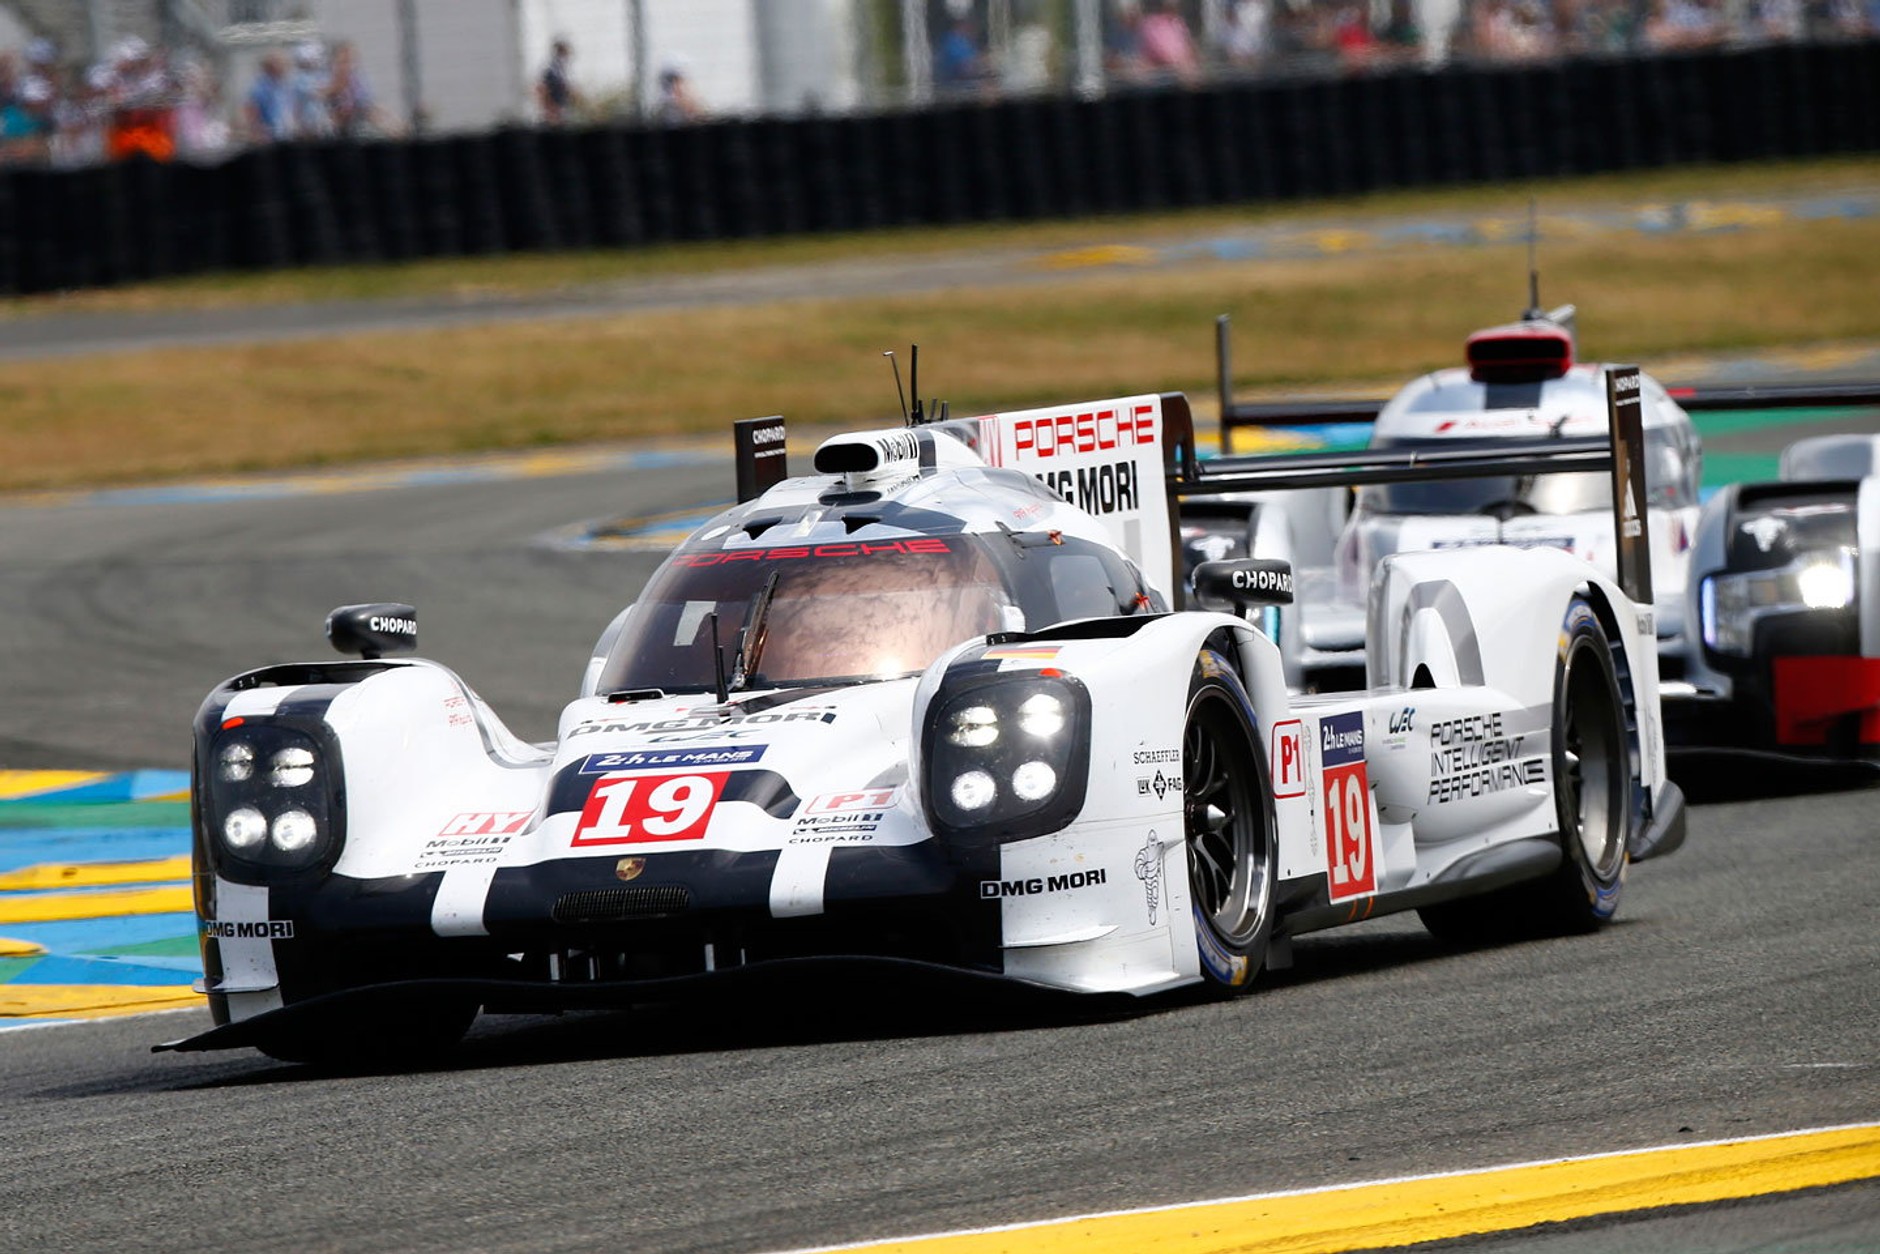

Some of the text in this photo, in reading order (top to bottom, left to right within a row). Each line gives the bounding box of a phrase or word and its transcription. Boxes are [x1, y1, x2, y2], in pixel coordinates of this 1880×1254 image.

[753, 425, 785, 444] CHOPARD
[1015, 405, 1154, 461] PORSCHE
[1078, 460, 1139, 516] MORI
[672, 538, 950, 567] PORSCHE
[370, 616, 417, 635] CHOPARD
[567, 715, 693, 740] DMG
[1389, 707, 1415, 734] WEC
[1431, 712, 1503, 748] PORSCHE
[1336, 733, 1345, 748] LE
[648, 754, 681, 764] LE
[681, 750, 753, 763] MANS
[1133, 749, 1180, 764] SCHAEFFLER
[1281, 734, 1302, 784] P1
[1431, 736, 1525, 776] INTELLIGENT
[1167, 777, 1183, 791] FAG
[1428, 758, 1546, 805] PERFORMANCE
[578, 775, 714, 840] 19
[825, 790, 894, 809] P1
[439, 812, 531, 836] HY
[797, 813, 859, 826] Mobil
[1329, 774, 1366, 884] 19
[425, 837, 488, 848] Mobil
[789, 835, 873, 844] CHOPARD
[414, 857, 497, 868] CHOPARD
[981, 868, 1106, 898] DMG MORI
[206, 922, 293, 938] DMG MORI
